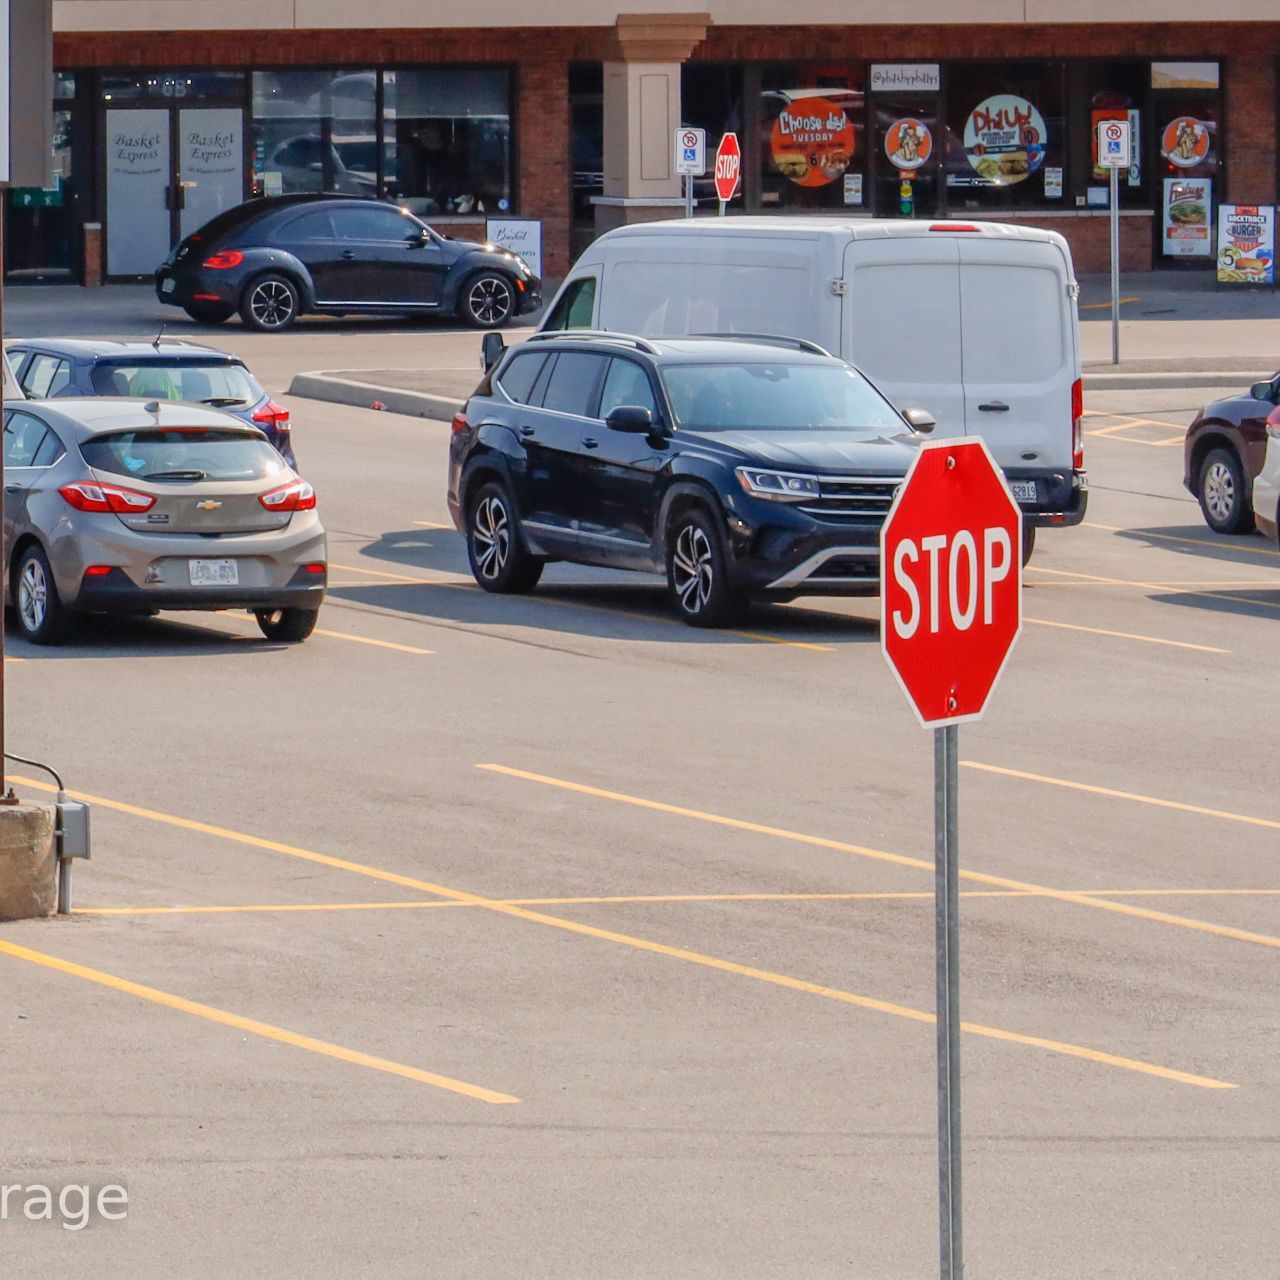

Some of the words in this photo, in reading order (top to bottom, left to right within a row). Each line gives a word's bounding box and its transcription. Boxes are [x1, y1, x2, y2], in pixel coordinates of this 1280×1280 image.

[114, 133, 161, 149] Basket
[188, 132, 235, 149] Basket
[792, 133, 834, 142] TUESDAY
[117, 149, 159, 164] Express
[191, 148, 232, 164] Express
[717, 154, 738, 180] STOP
[1231, 224, 1262, 236] BURGER
[892, 526, 1012, 640] STOP
